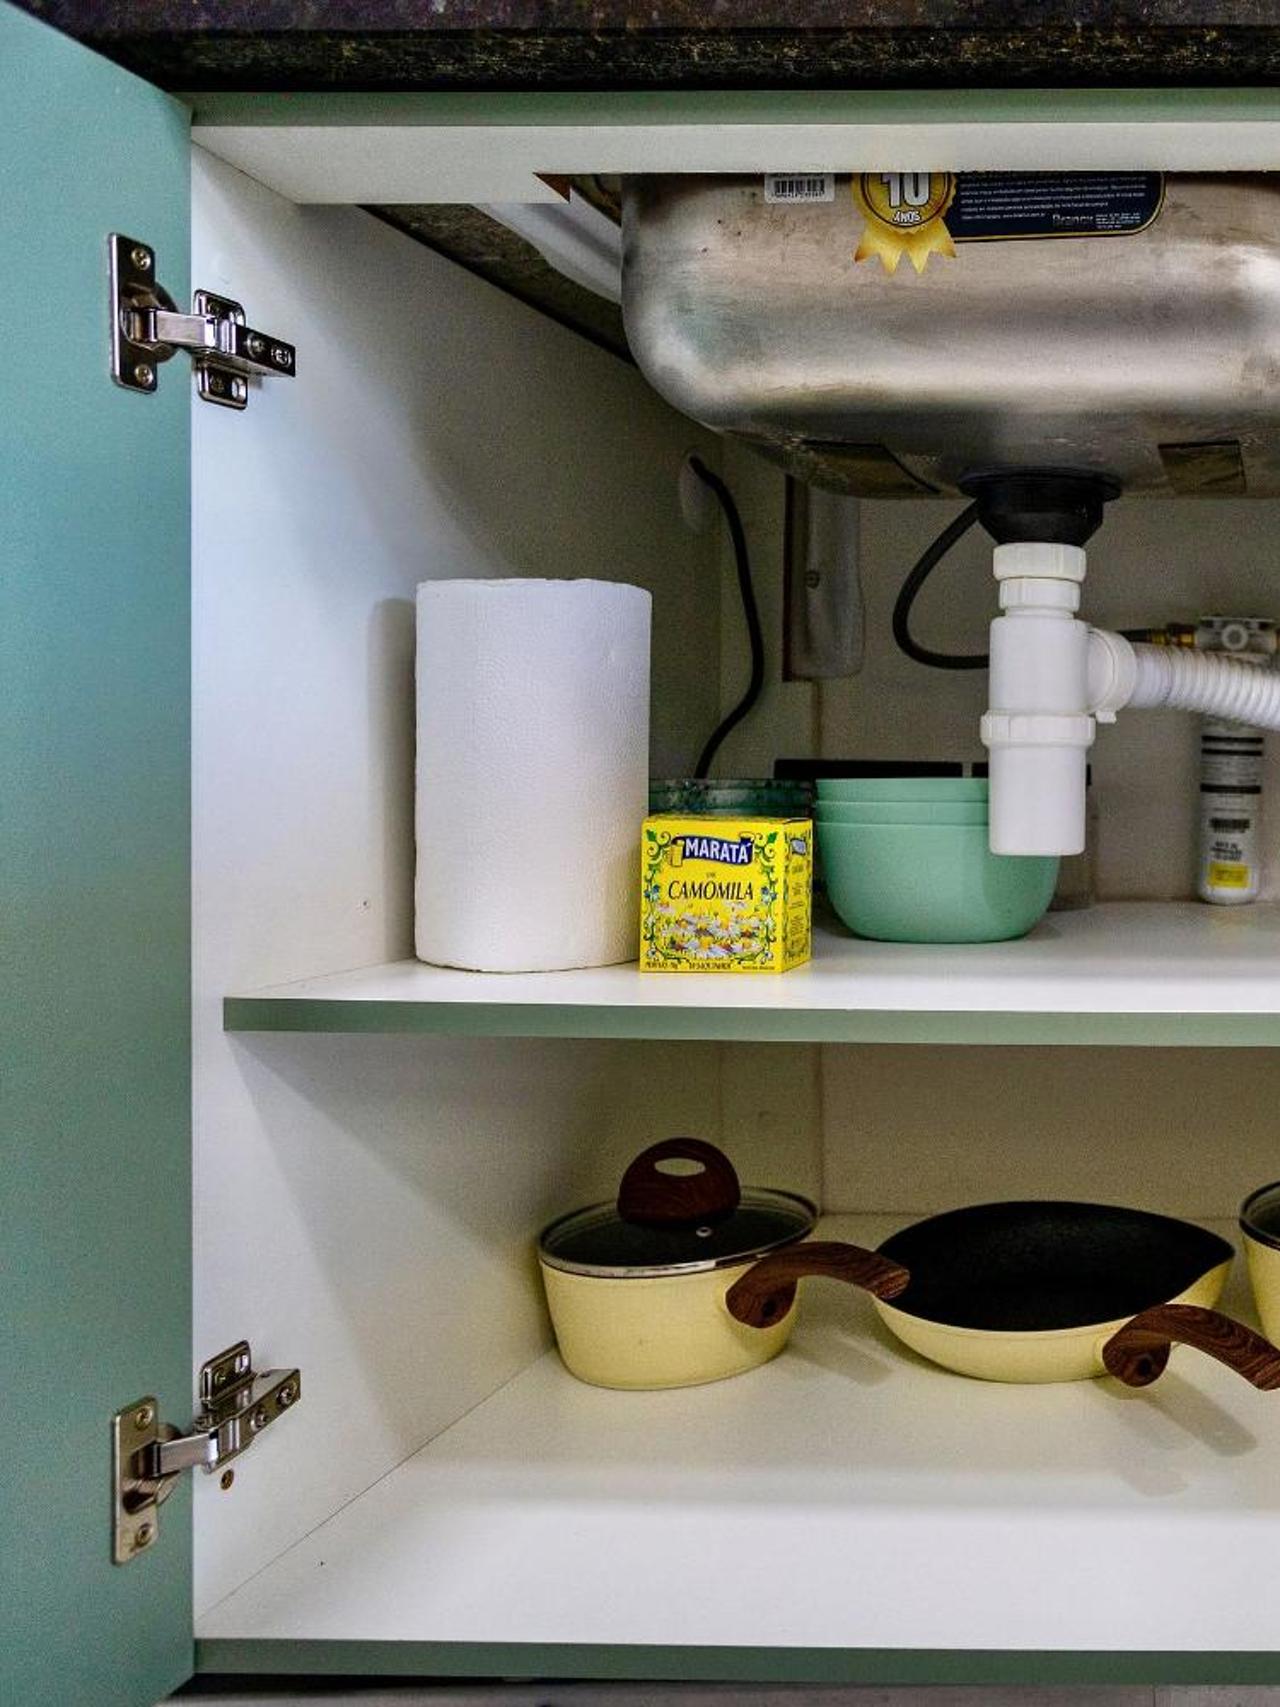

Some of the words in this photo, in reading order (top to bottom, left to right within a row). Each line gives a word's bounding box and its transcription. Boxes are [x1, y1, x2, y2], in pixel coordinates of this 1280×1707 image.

[881, 173, 930, 207] 10
[685, 838, 752, 863] MARATÁ
[668, 880, 753, 899] CAMOMILA
